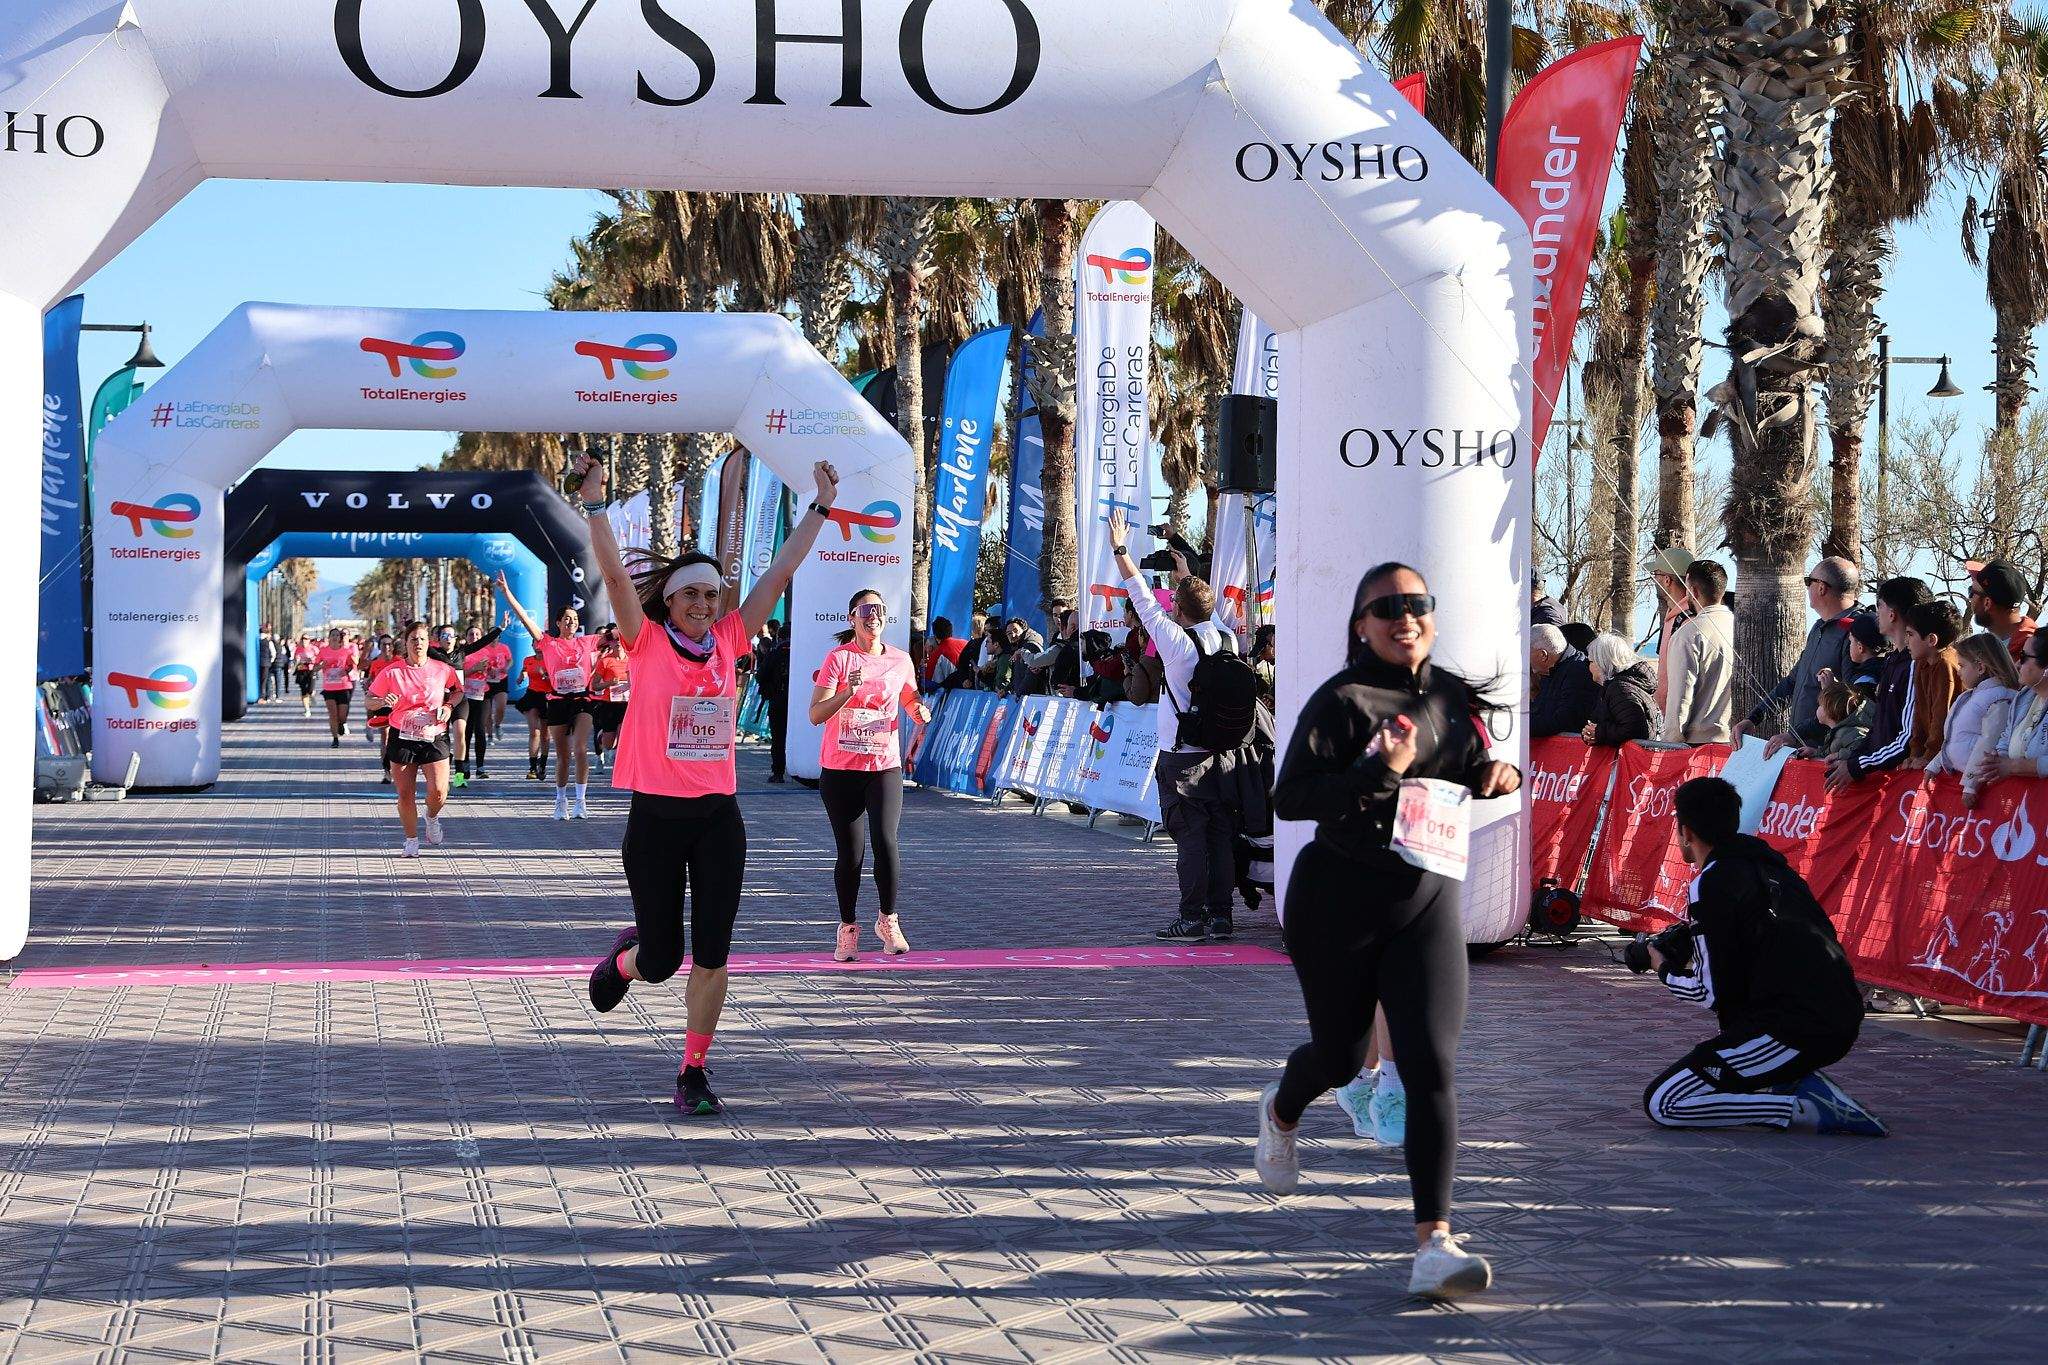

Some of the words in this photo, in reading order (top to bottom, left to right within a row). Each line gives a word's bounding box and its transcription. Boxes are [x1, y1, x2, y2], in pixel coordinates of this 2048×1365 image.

[333, 0, 1041, 116] OYSHO
[1235, 142, 1429, 183] OYSHO
[361, 388, 466, 403] TotalEnergies
[575, 390, 678, 405] TotalEnergies
[176, 415, 260, 429] LasCarreras
[890, 412, 936, 422] VVO
[1122, 345, 1144, 488] LasCarreras
[789, 422, 867, 436] LasCarreras
[1339, 428, 1517, 469] OYSHO
[300, 492, 493, 510] VOLVO
[727, 510, 737, 554] Institutos
[110, 547, 200, 562] TotalEnergies
[818, 550, 900, 566] TotalEnergies
[109, 611, 199, 624] totalenergies.es
[106, 718, 197, 733] TotalEnergies
[692, 725, 716, 736] 016
[1427, 820, 1456, 840] 016
[1890, 789, 1991, 858] Sports
